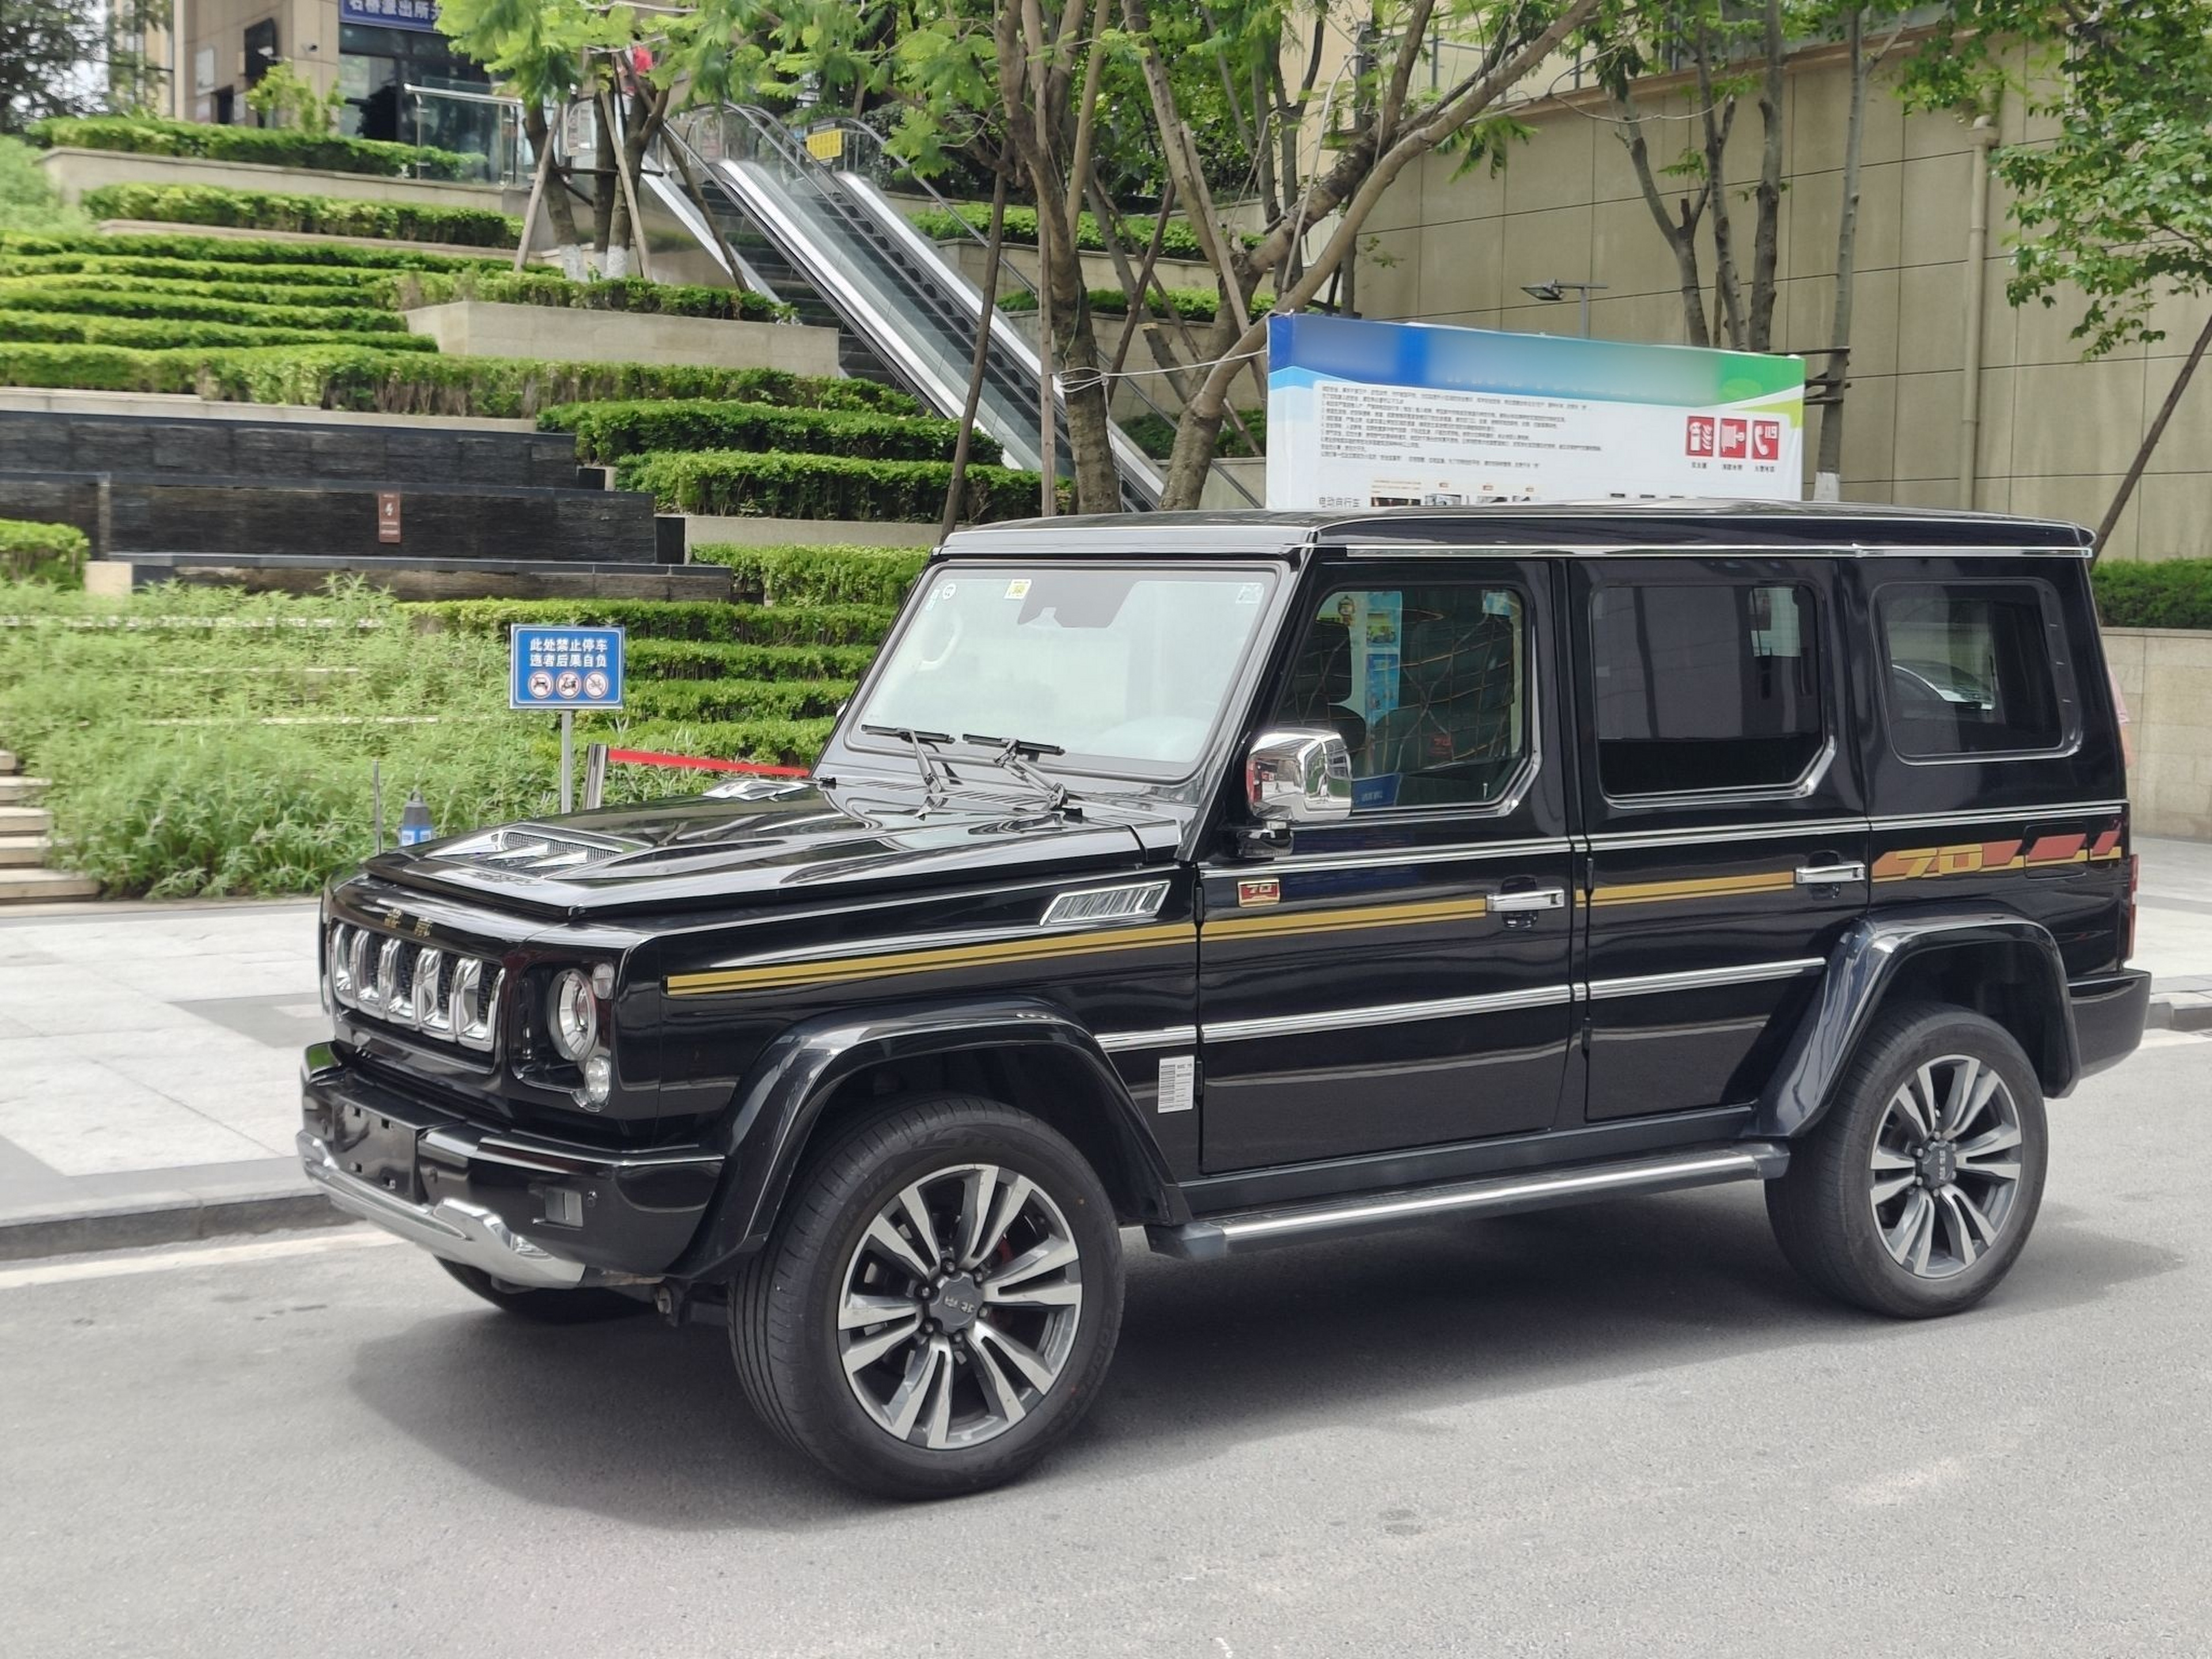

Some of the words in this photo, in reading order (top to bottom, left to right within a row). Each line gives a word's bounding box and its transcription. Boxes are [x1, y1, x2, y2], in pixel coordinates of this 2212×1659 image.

[529, 638, 608, 652] 此处禁止停车
[529, 653, 607, 668] 违者后果自负
[1896, 843, 1984, 878] 70
